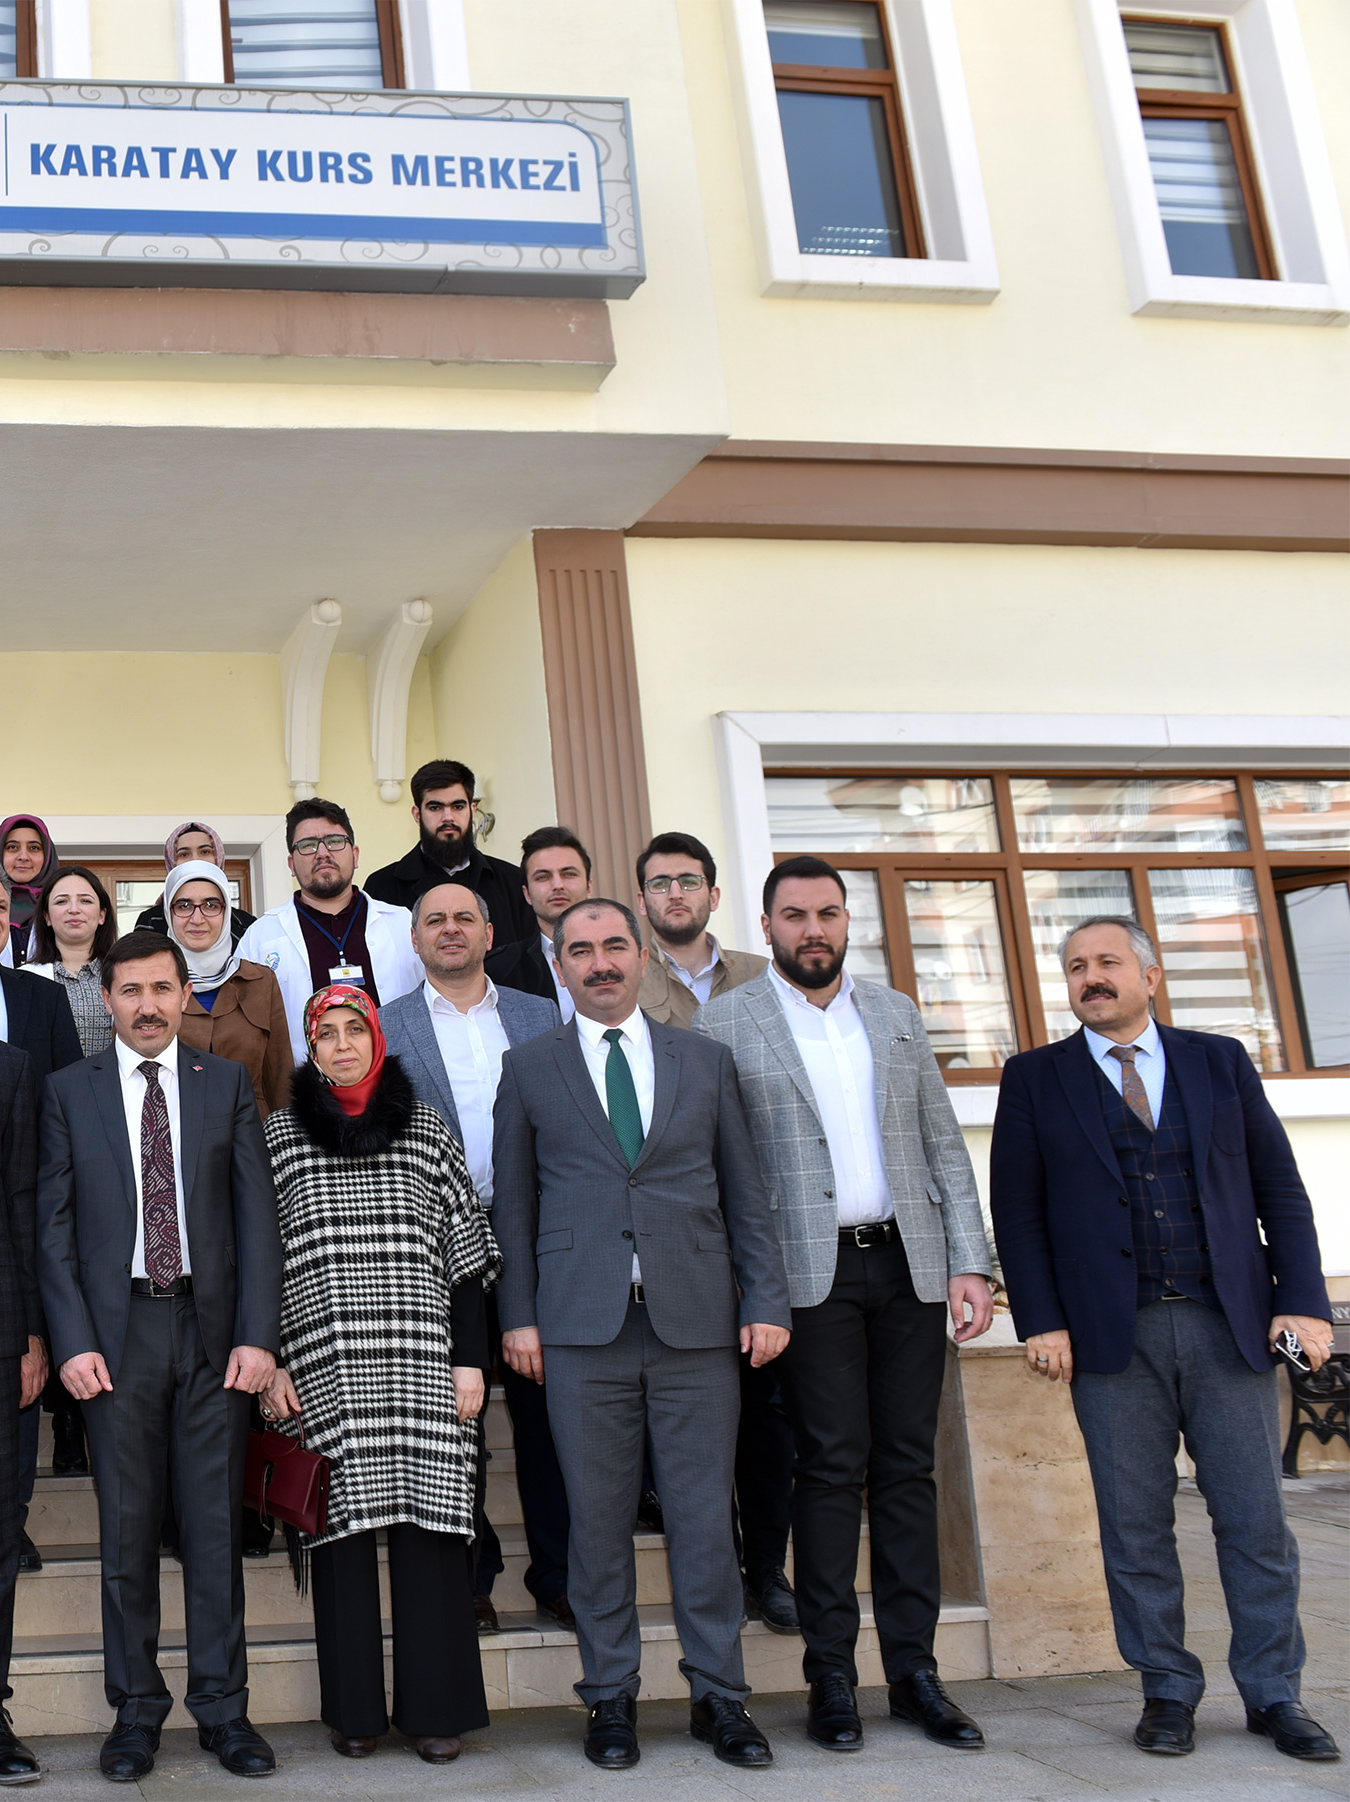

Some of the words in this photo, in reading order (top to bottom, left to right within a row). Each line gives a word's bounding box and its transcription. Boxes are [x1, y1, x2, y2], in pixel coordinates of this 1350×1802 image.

[30, 142, 238, 181] KARATAY
[257, 149, 374, 185] KURS
[391, 151, 582, 192] MERKEZİ
